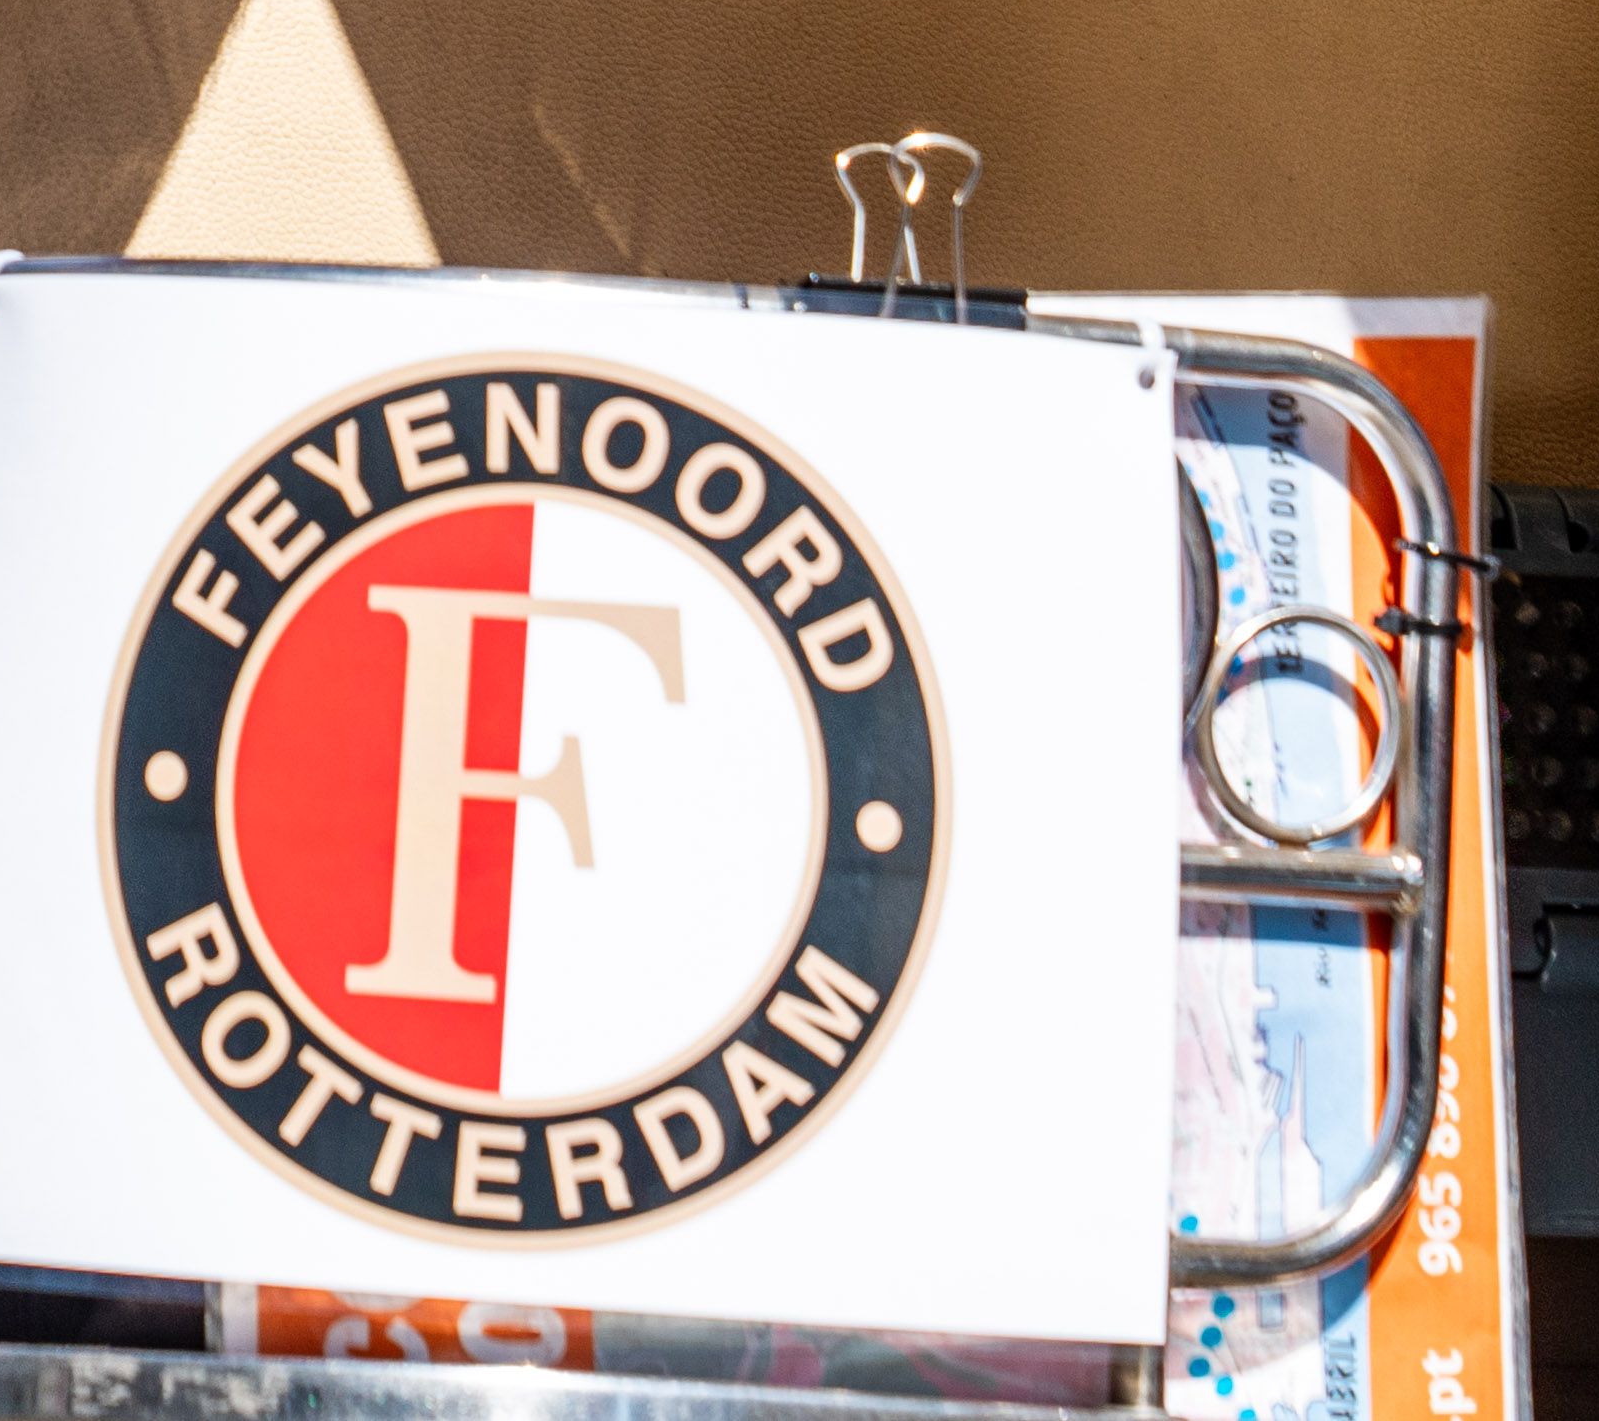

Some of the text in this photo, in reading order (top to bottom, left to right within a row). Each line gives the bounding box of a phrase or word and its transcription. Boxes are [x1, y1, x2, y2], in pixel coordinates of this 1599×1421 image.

[171, 381, 896, 693] FEYENOORD
[1267, 390, 1305, 674] TEREIRO DO PAÇO
[344, 583, 687, 1005] F
[145, 901, 881, 1222] ROTTERDAM
[1418, 1170, 1463, 1276] 965
